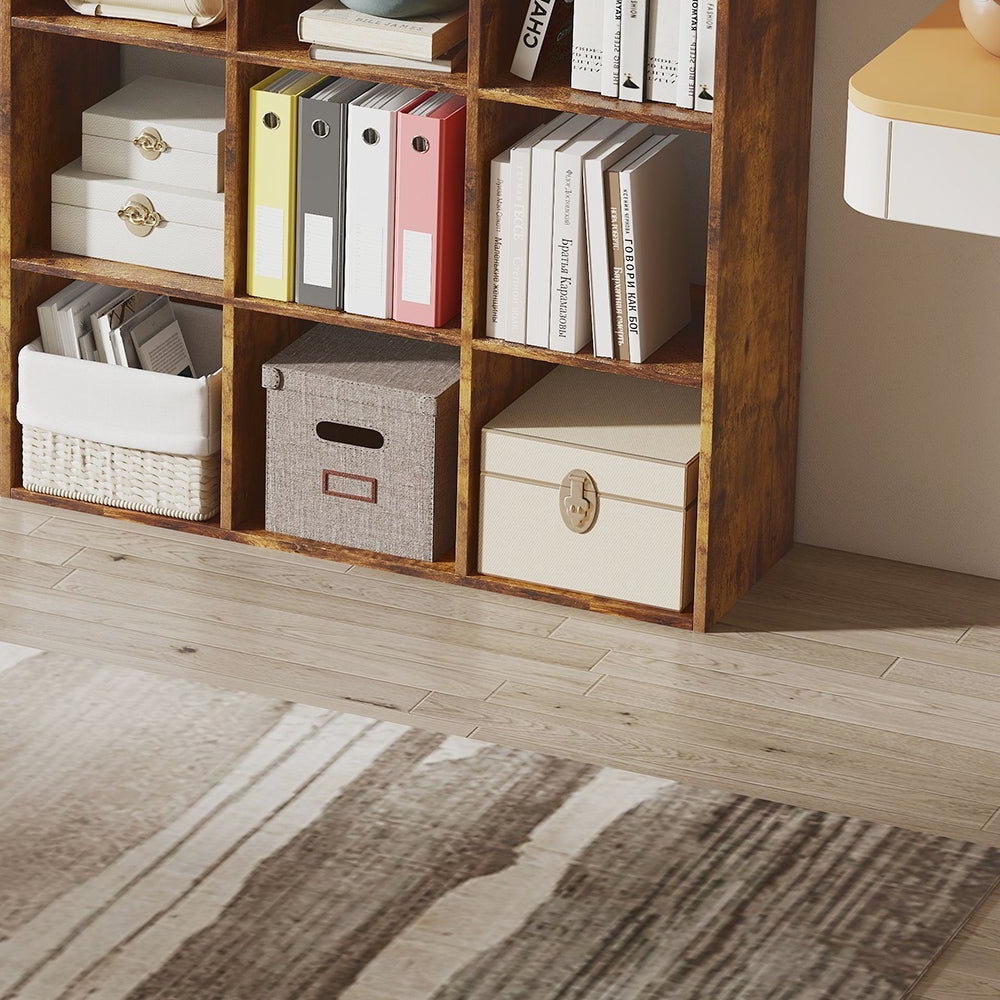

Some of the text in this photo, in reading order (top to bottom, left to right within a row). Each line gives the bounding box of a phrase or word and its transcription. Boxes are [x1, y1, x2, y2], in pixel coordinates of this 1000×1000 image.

[706, 2, 714, 29] FASHION
[492, 236, 503, 283] Маленькие
[624, 238, 636, 288] ГОВОРИ
[491, 283, 499, 324] женщины
[556, 238, 573, 338] Братья Карамазовы
[627, 291, 637, 312] КАК
[628, 315, 639, 336] БОГ
